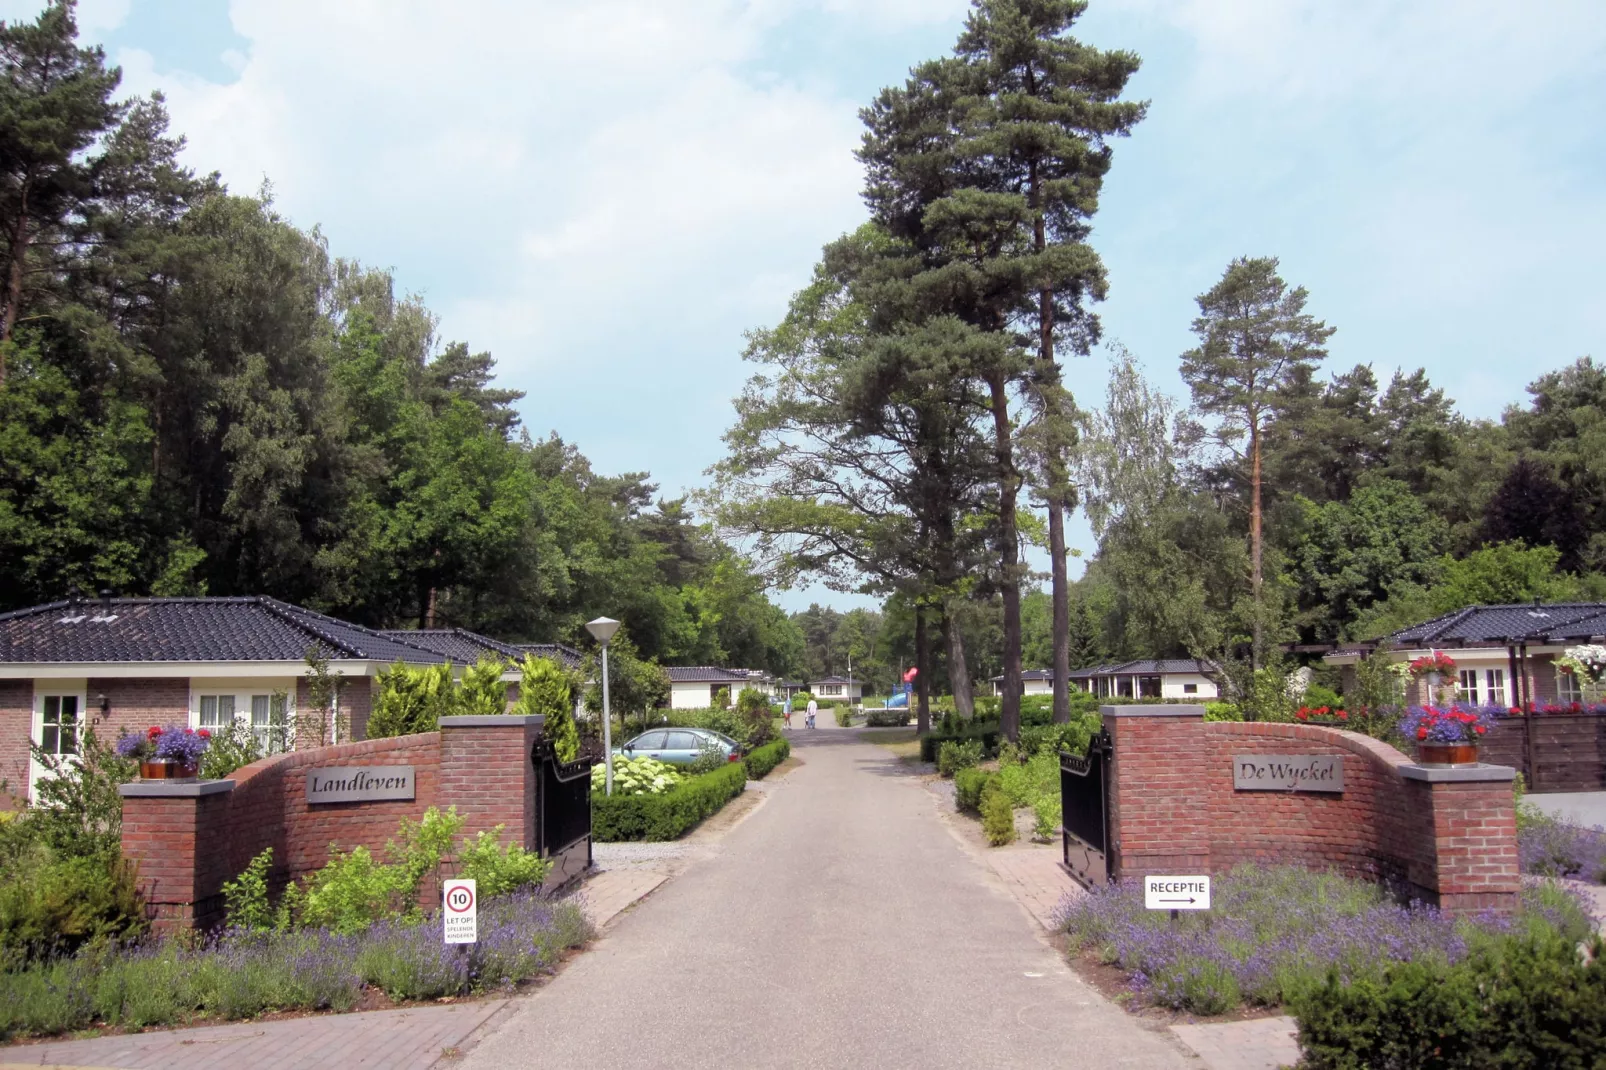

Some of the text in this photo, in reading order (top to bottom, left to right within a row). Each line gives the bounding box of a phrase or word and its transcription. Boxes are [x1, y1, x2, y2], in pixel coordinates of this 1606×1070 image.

[312, 771, 406, 793] Landleven
[1239, 760, 1334, 788] De Wyckel
[1151, 882, 1205, 893] RECEPTIE
[453, 894, 467, 904] 10
